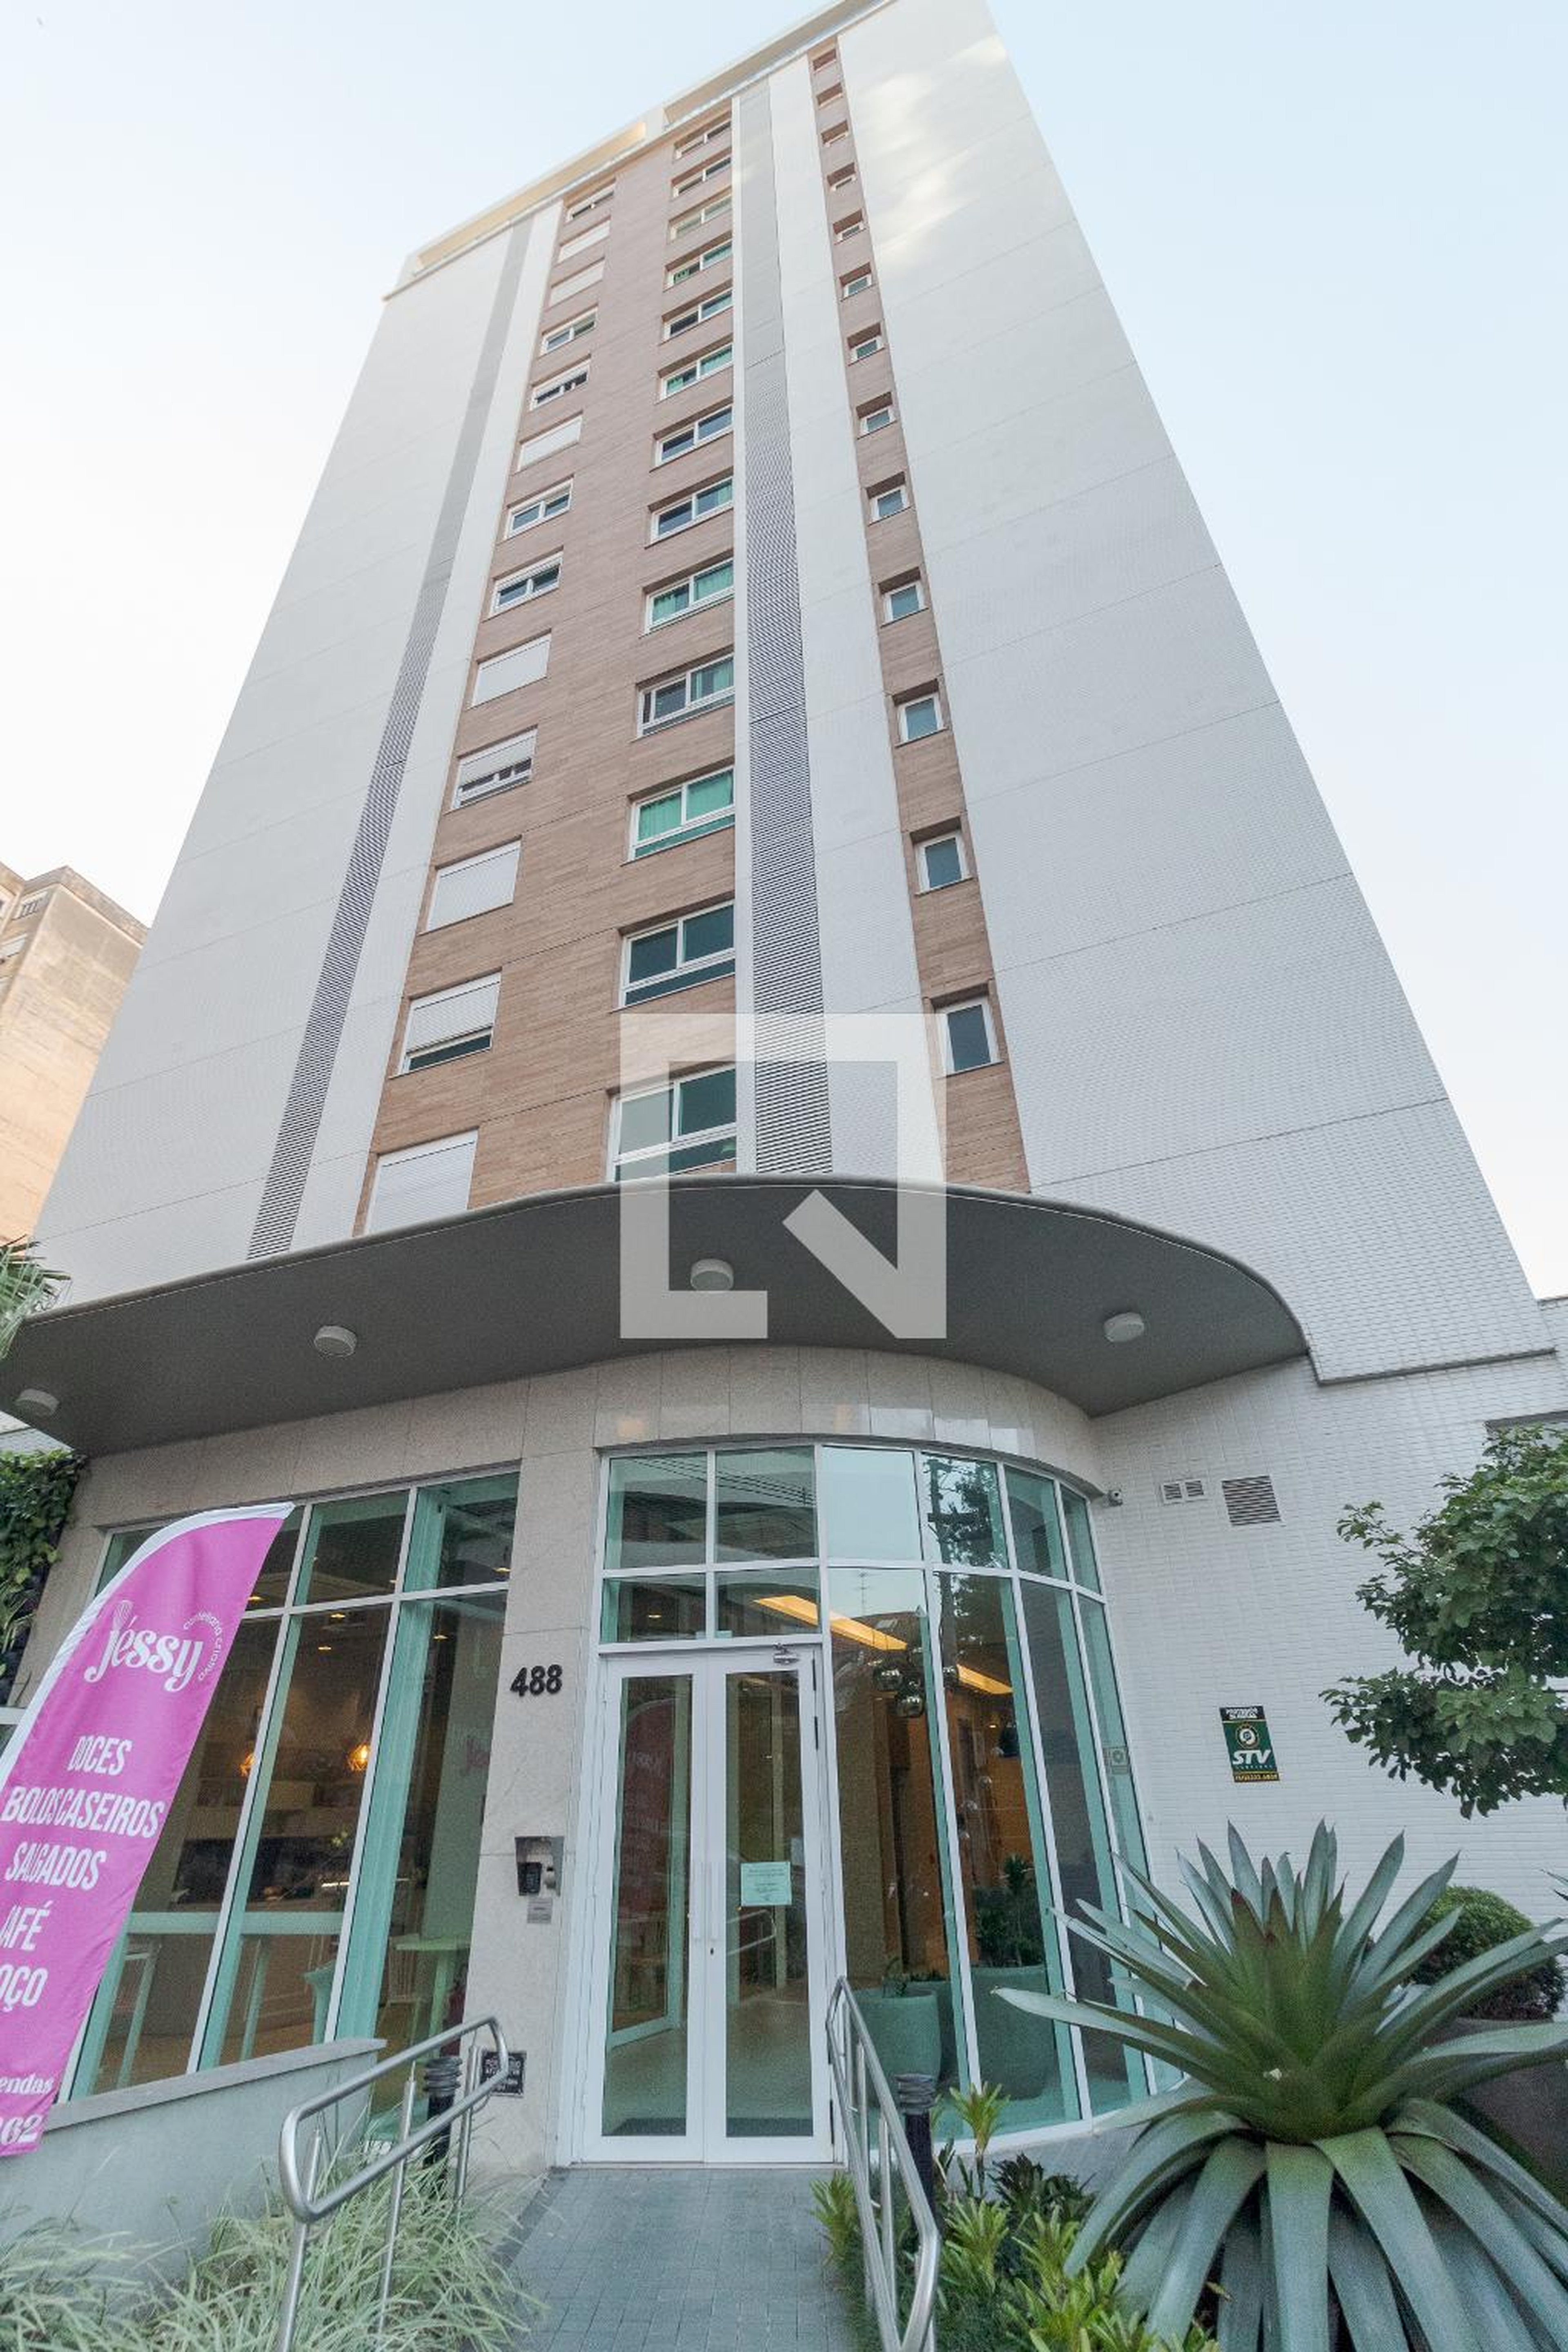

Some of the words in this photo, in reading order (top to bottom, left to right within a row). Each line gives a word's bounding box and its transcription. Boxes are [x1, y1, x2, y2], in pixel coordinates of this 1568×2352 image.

[510, 1664, 562, 1697] 488
[1233, 1750, 1271, 1764] STV
[0, 2114, 42, 2144] 62
